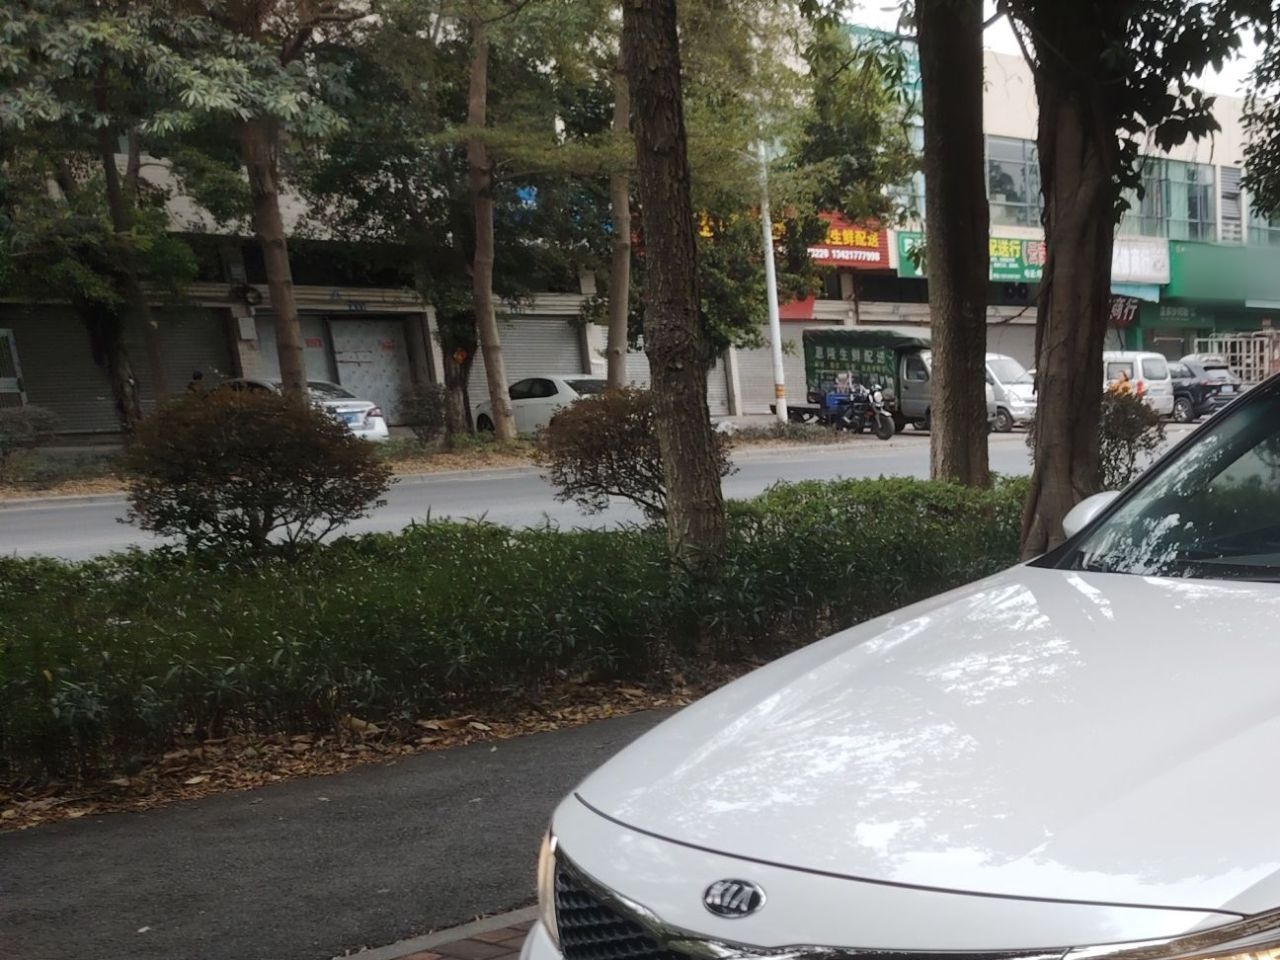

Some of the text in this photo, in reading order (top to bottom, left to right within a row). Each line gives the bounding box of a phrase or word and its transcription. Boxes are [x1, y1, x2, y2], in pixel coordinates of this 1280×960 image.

[825, 229, 880, 248] 生鲜配送
[704, 880, 756, 913] KIA
